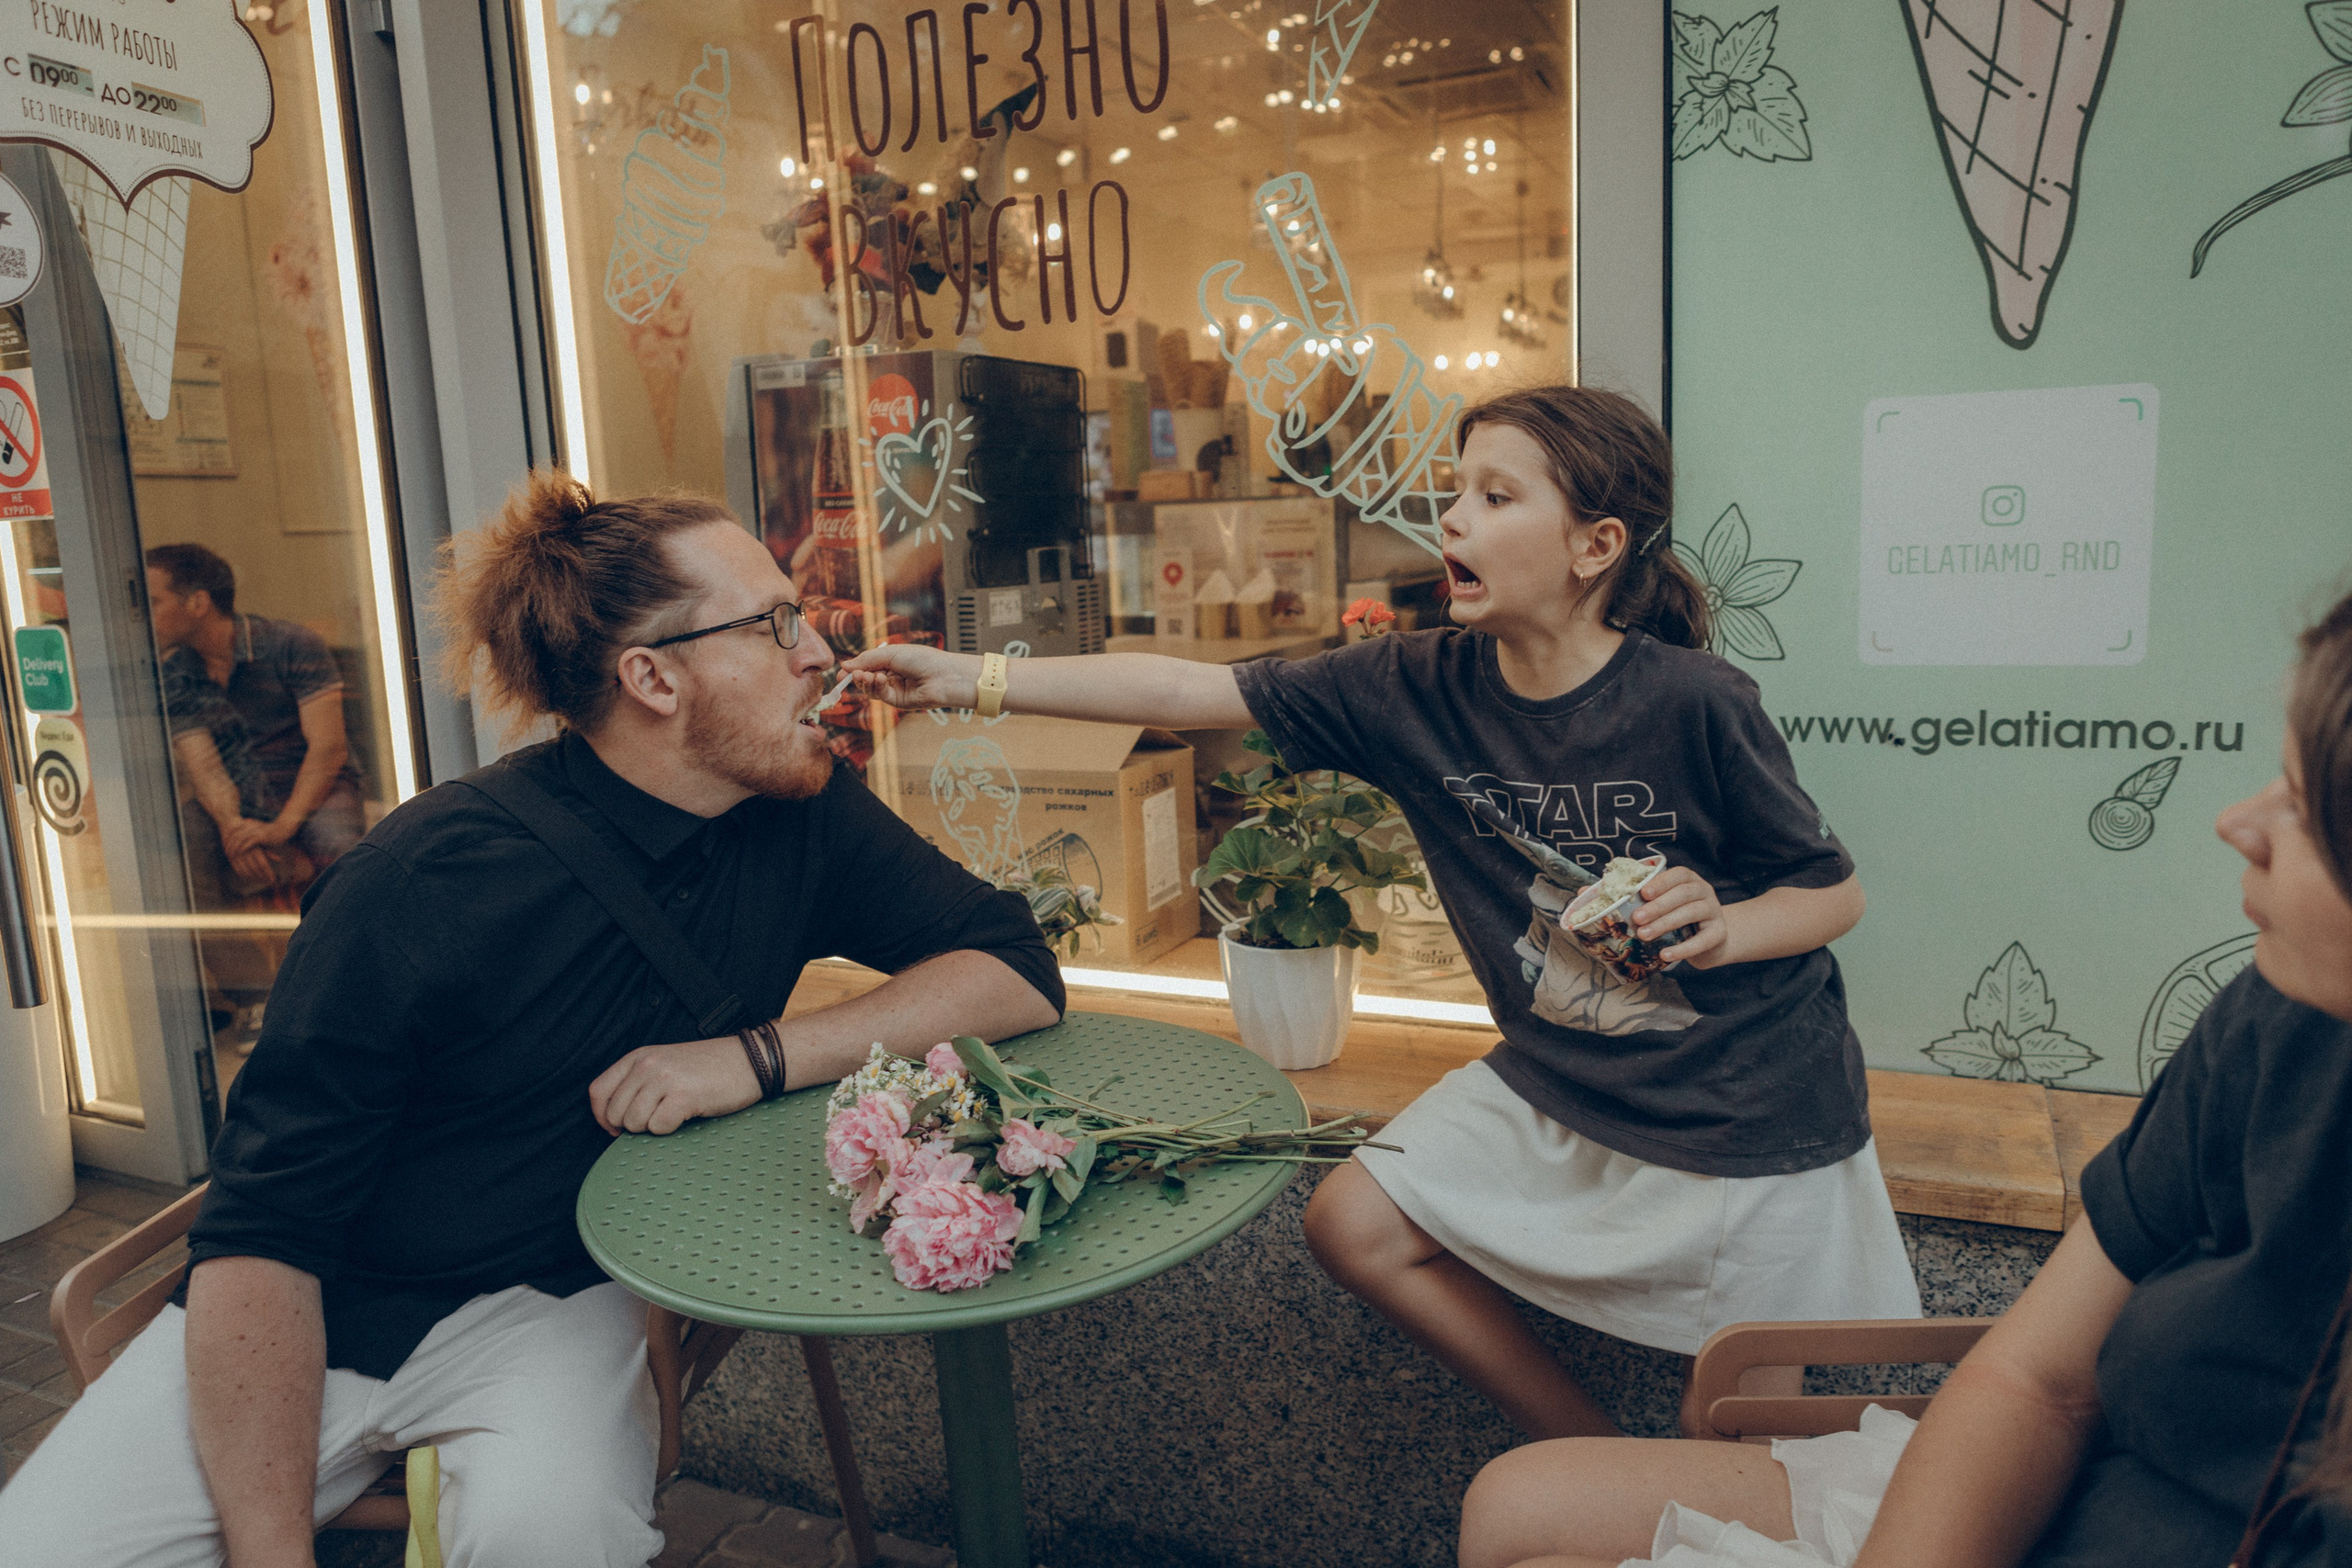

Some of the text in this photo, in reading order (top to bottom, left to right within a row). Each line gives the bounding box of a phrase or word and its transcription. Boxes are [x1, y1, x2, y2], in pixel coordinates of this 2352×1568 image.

[30, 0, 177, 71] РЕЖИМ РАБОТЫ
[789, 0, 1170, 164] ПОЛЕЗНО
[21, 96, 203, 159] БЕЗ ПЕРЕРЫВОВ И ВЫХОДНЫХ
[840, 180, 1130, 346] ВКУСНО
[11, 492, 23, 502] НЕ
[1887, 540, 2121, 577] GELATIAMO_RND
[23, 658, 63, 673] Delivery
[26, 672, 49, 686] Club
[1779, 710, 2244, 755] www.gelatiamo.ru
[1057, 786, 1114, 797] сахарных
[1443, 773, 1677, 840] STAR
